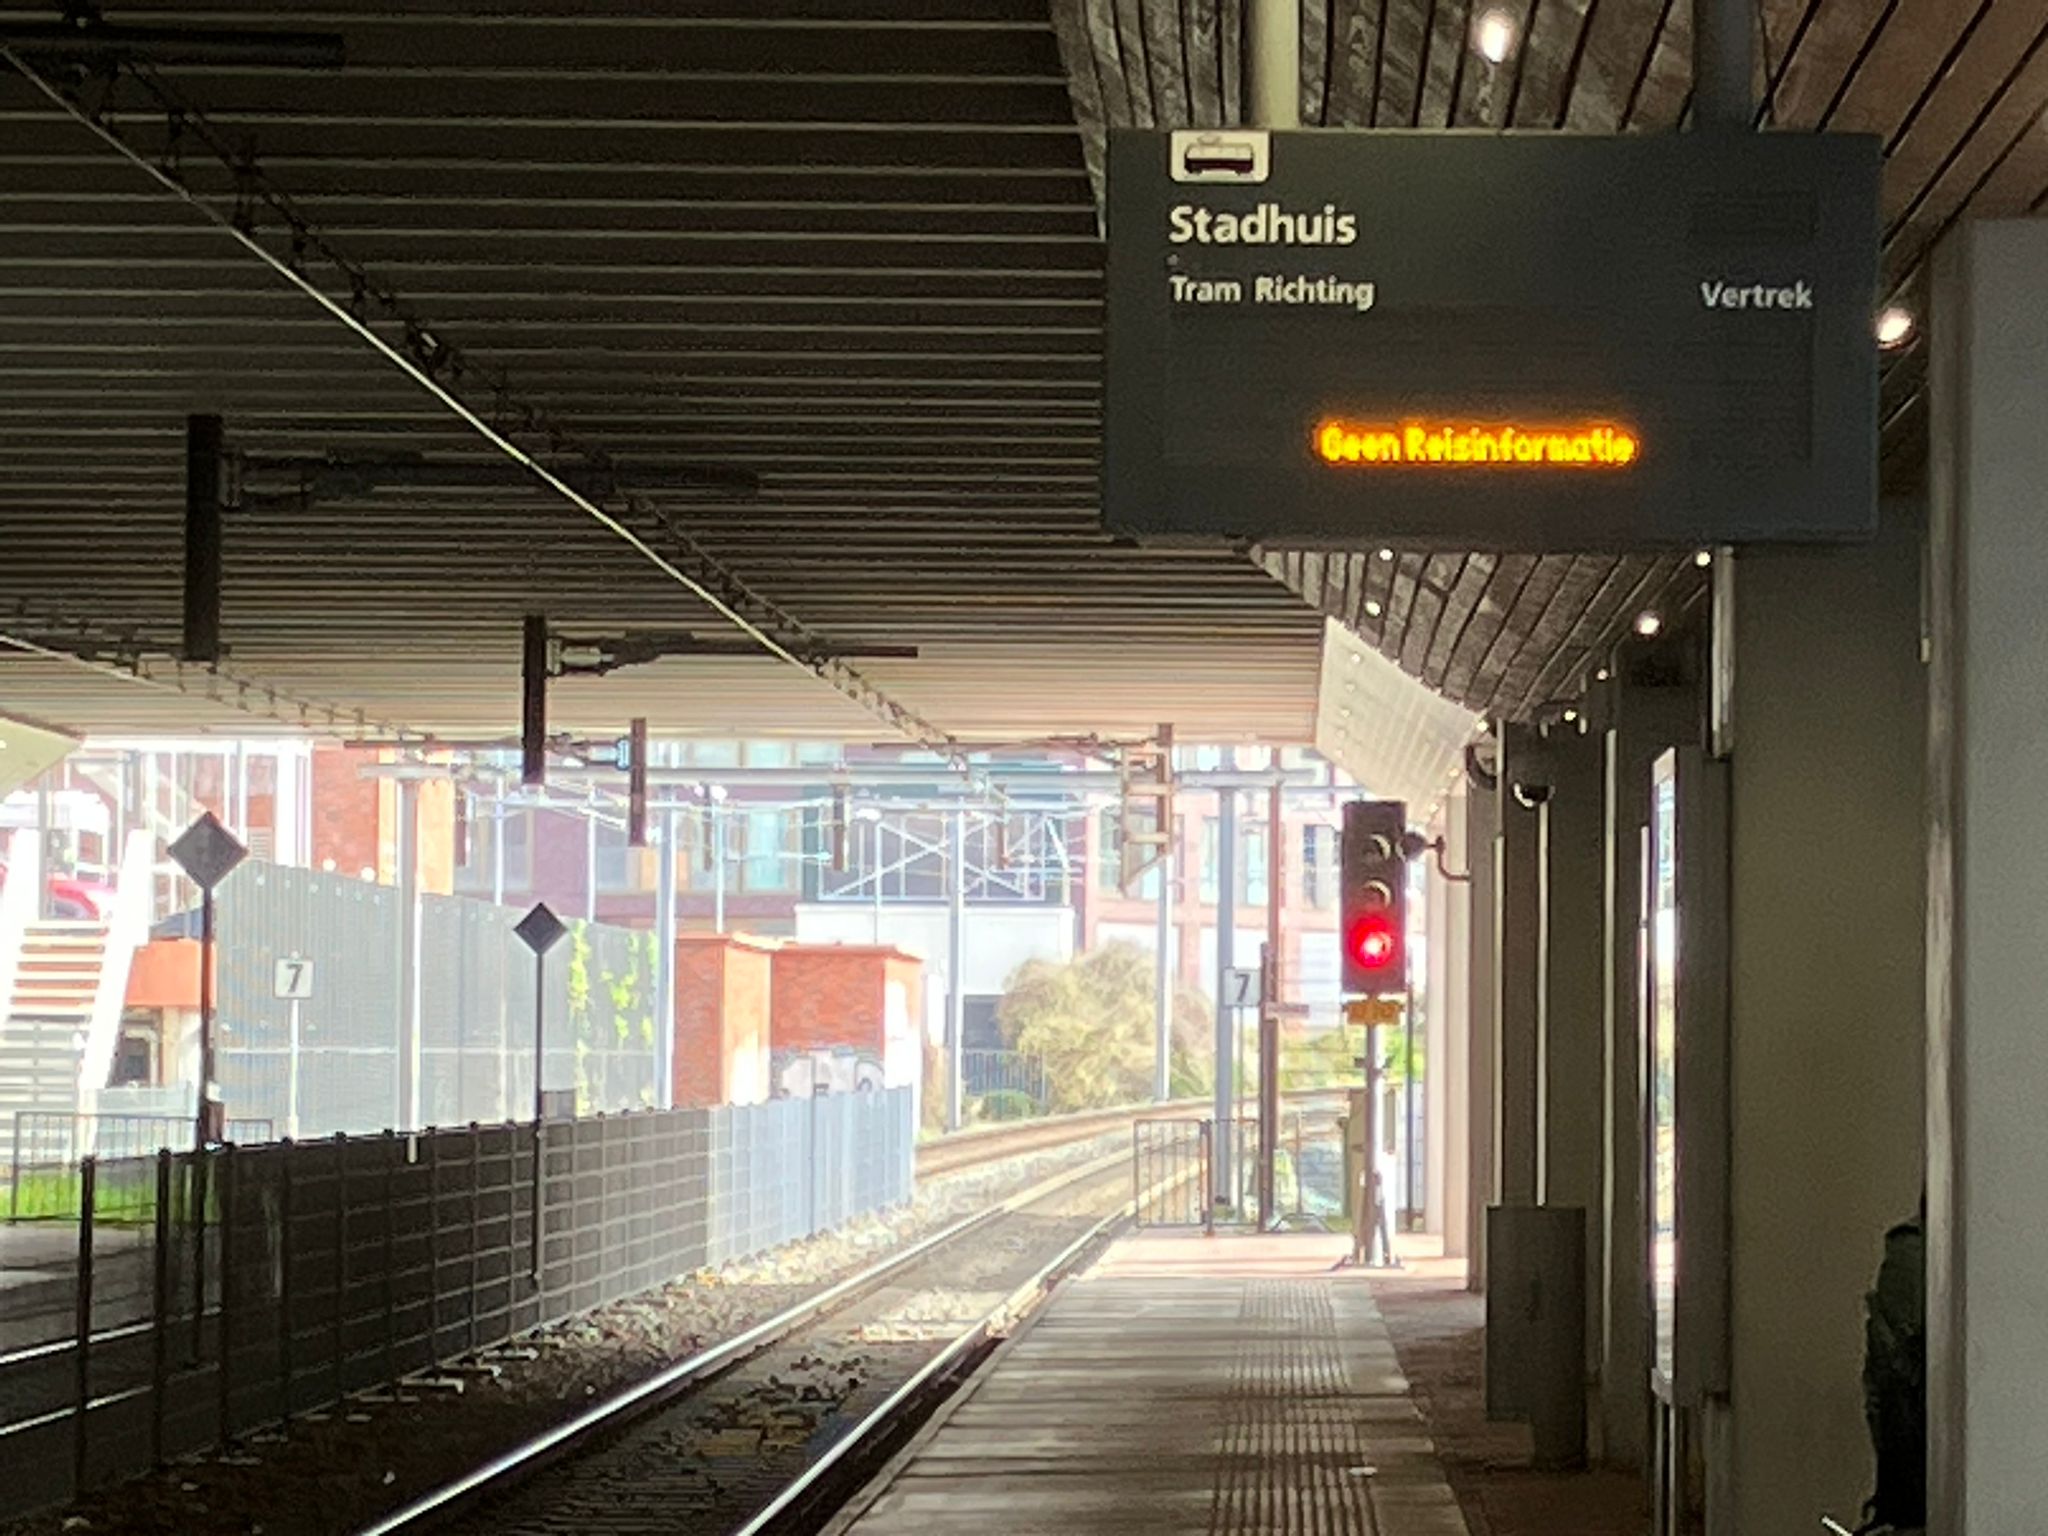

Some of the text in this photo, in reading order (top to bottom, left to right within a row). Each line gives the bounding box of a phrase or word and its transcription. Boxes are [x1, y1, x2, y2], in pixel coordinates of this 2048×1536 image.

[1169, 203, 1357, 244] Stadhuis
[1169, 274, 1375, 311] Tram Richting
[1701, 280, 1813, 309] Vertrek
[1321, 426, 1636, 463] Geen Reisinformatie
[286, 963, 304, 993] 7
[1234, 973, 1250, 1002] 7
